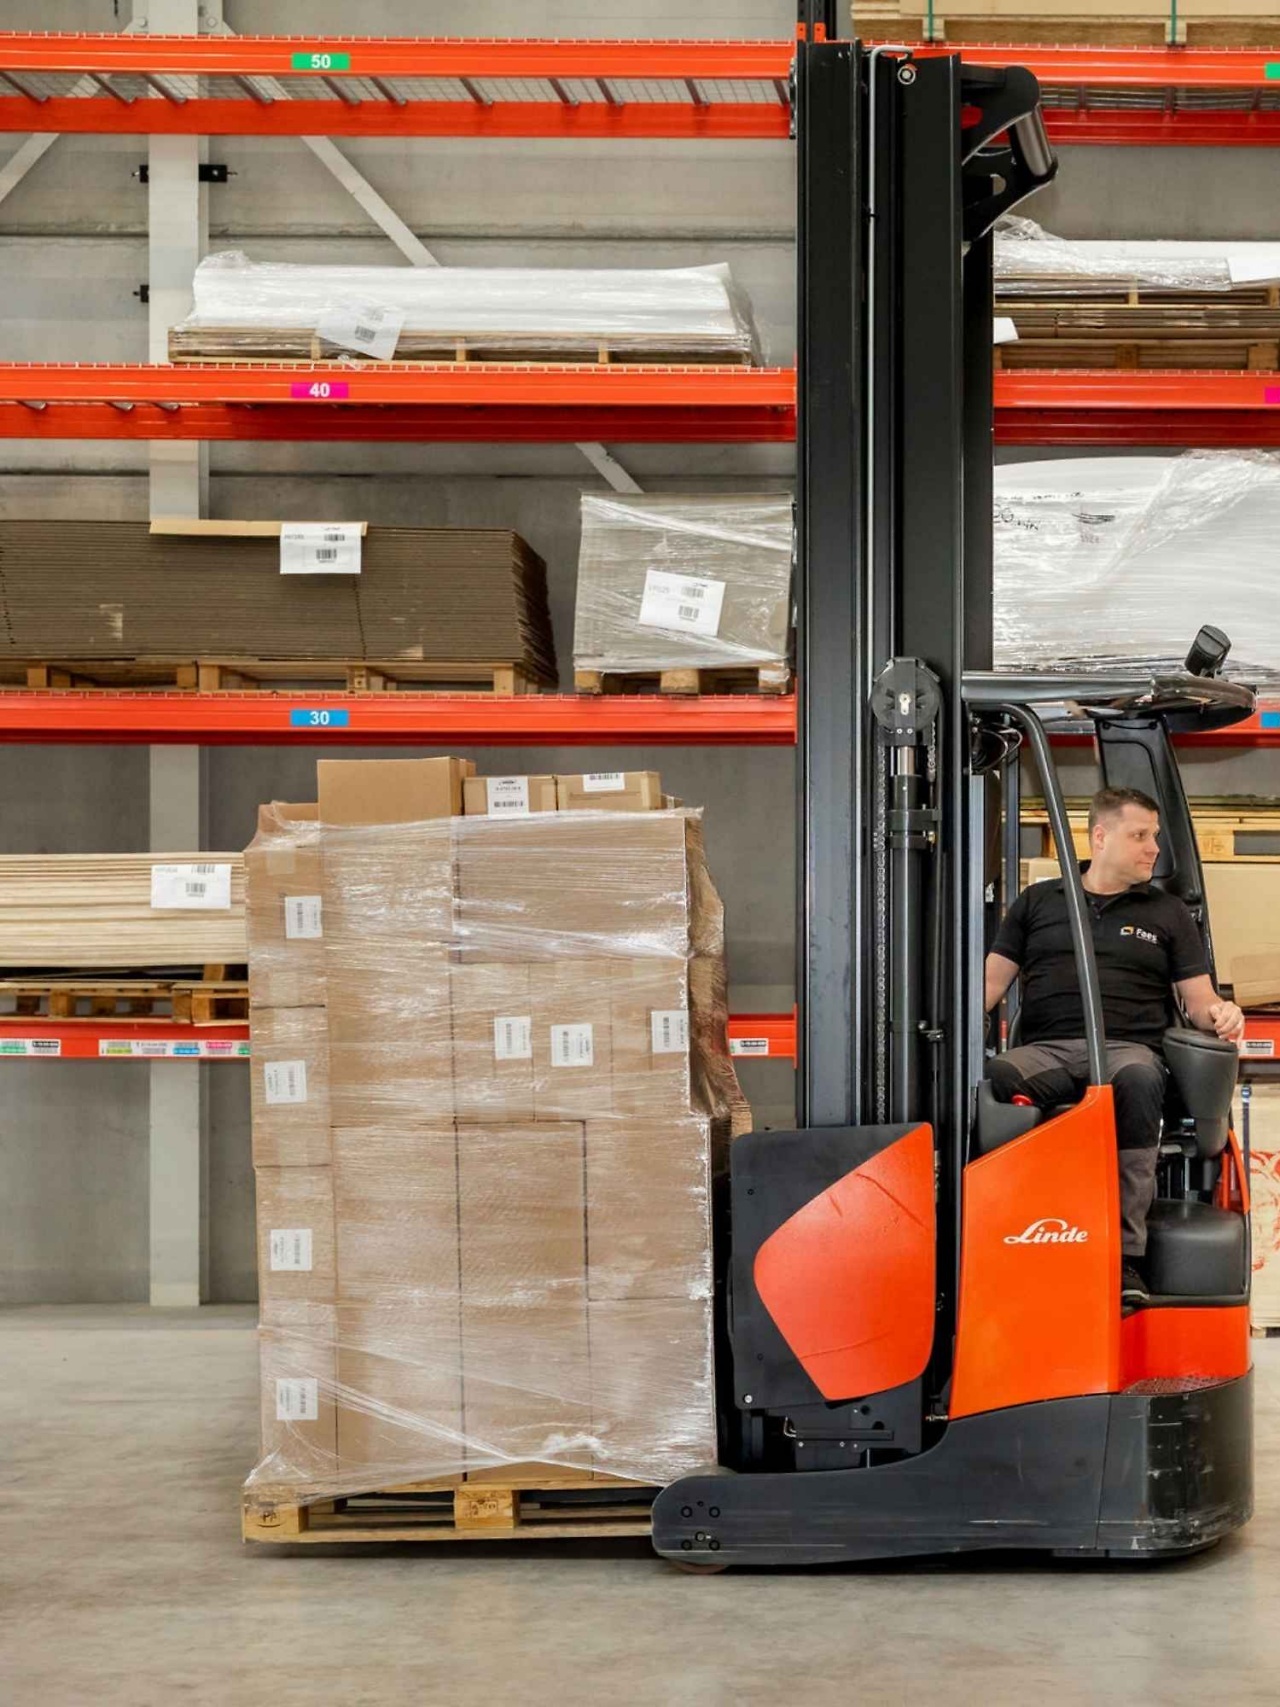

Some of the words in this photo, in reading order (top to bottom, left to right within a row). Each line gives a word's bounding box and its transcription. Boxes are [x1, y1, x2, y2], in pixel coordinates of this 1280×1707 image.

[311, 54, 331, 68] 50
[309, 383, 331, 397] 40
[310, 710, 330, 725] 30
[1003, 1217, 1089, 1245] Linde
